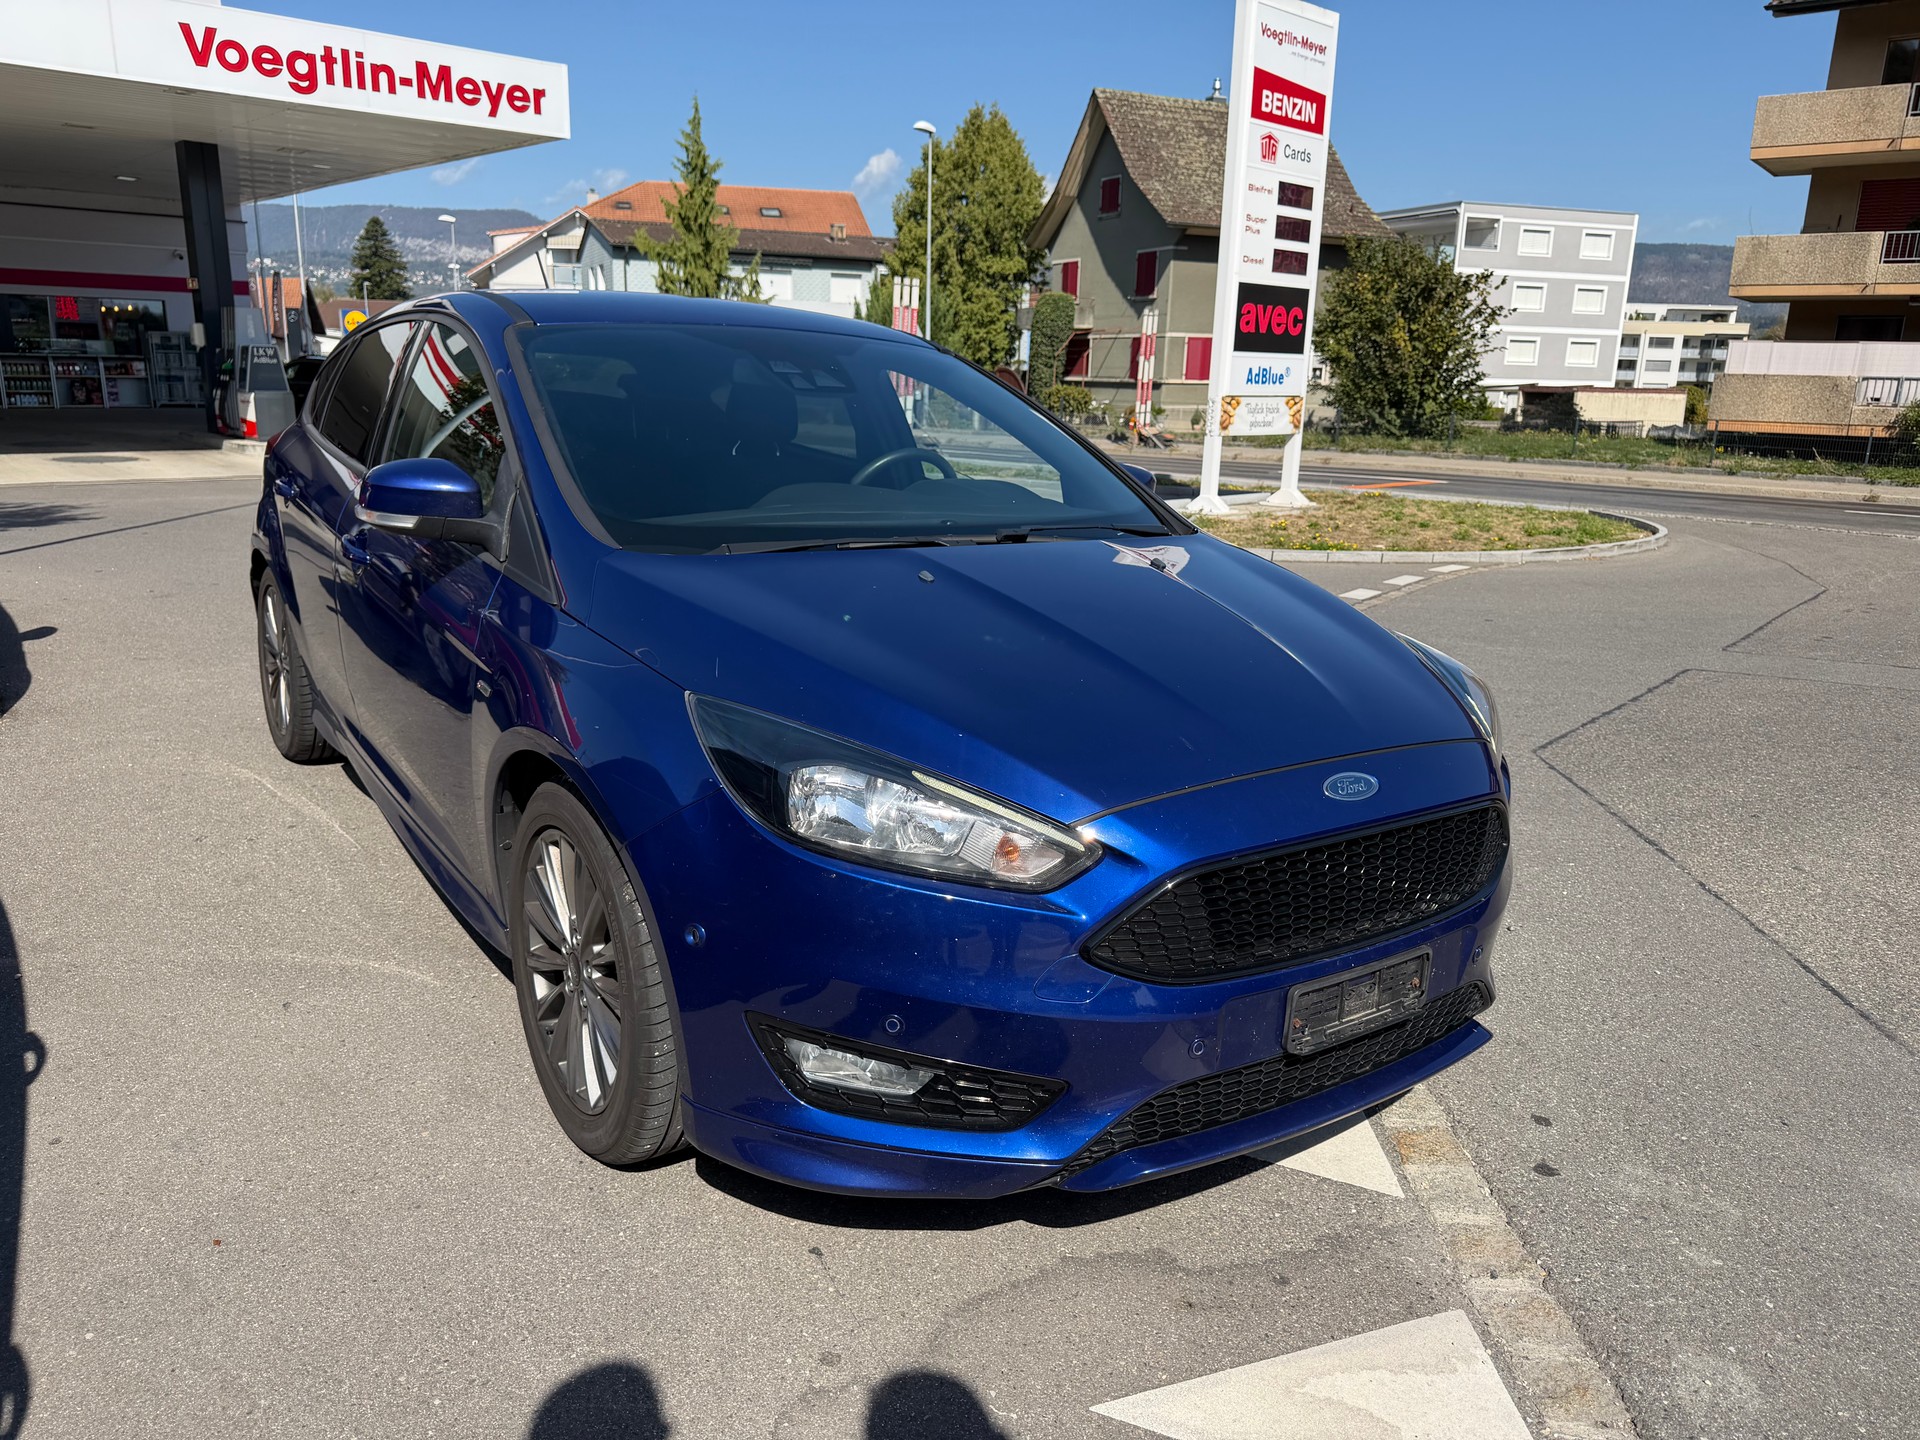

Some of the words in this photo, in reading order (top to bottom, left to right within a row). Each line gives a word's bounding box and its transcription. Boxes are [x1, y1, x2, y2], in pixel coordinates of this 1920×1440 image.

[1261, 22, 1327, 56] Voegtlin-Meyer
[178, 22, 546, 118] Voegtlin-Meyer
[1261, 89, 1317, 125] BENZIN
[1283, 144, 1312, 163] Cards
[1248, 183, 1273, 196] Bleifrei
[1246, 214, 1267, 225] Super
[1245, 225, 1260, 235] Plus
[1242, 255, 1264, 265] Diesel
[1239, 302, 1304, 337] avec
[253, 347, 275, 356] LKW
[1337, 777, 1368, 796] Ford
